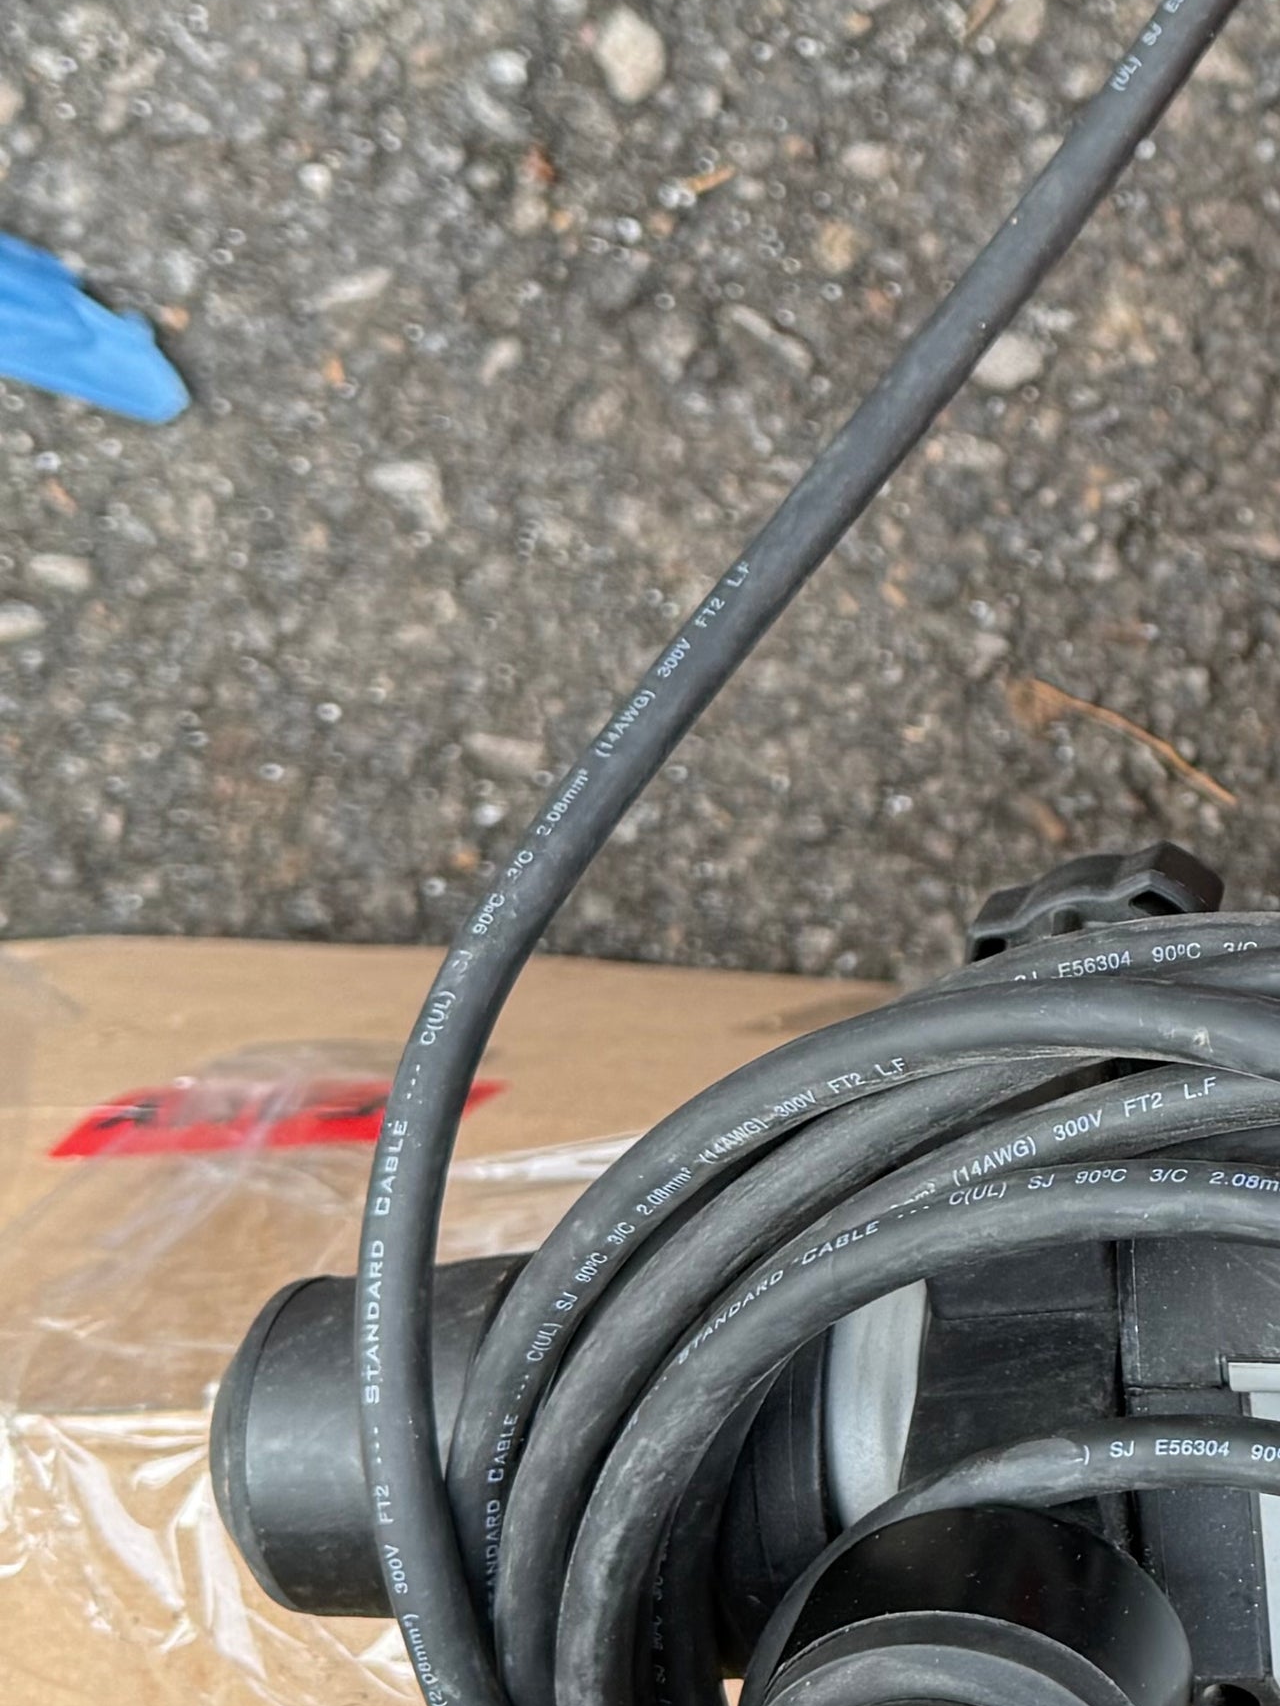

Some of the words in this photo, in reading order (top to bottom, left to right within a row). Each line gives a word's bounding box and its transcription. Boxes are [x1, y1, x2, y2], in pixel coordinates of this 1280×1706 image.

[694, 596, 726, 629] FT2
[656, 638, 693, 679] 300V
[594, 689, 656, 759] (14AWG)
[1057, 950, 1132, 978] E56304
[419, 989, 457, 1046] C(UL)
[952, 1135, 1037, 1186] (14AWG)
[1052, 1110, 1103, 1142] 300V
[1123, 1092, 1164, 1118] FT2
[1183, 1076, 1217, 1101] L.F
[373, 1119, 409, 1217] CABLE
[487, 1413, 520, 1485] CABLE
[525, 1322, 562, 1363] C(UL)
[556, 1293, 578, 1312] SJ
[606, 1221, 637, 1245] 3/C
[698, 1116, 769, 1165] (14AWG)
[772, 1090, 818, 1118] 300V
[827, 1072, 865, 1094] FT2
[677, 1269, 784, 1365] STANDARD
[801, 1220, 880, 1265] CABLE
[948, 1180, 1008, 1206] C(UL)
[1027, 1174, 1055, 1190] SJ
[1149, 1168, 1188, 1183] 3/C
[364, 1239, 386, 1406] STANDARD
[1110, 1440, 1135, 1458] SJ
[1154, 1439, 1231, 1457] E56304
[376, 1483, 395, 1526] FT2
[383, 1543, 409, 1595] 300V
